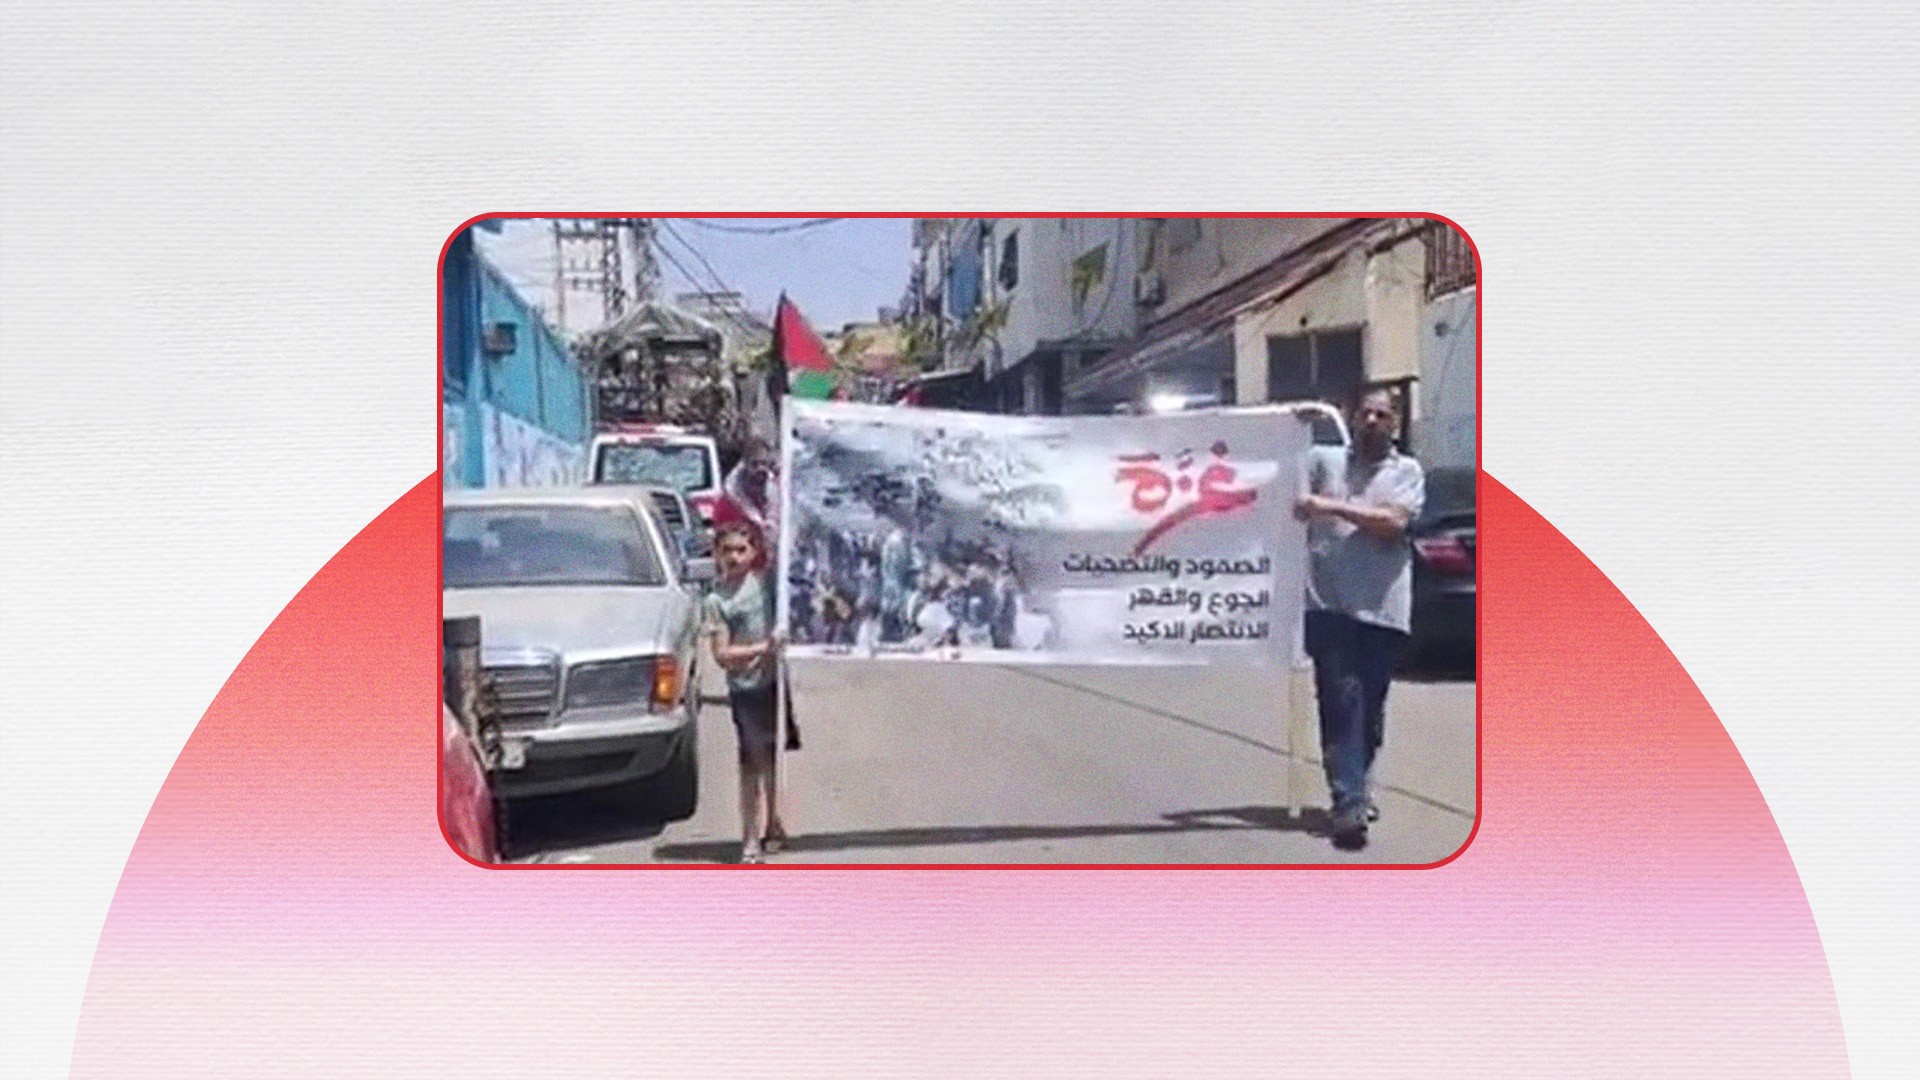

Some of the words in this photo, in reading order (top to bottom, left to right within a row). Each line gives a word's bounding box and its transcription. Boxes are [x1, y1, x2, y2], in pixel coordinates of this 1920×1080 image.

[1062, 554, 1180, 578] والتضحيات
[1186, 556, 1271, 579] الصمود
[1128, 588, 1201, 612] والقهر
[1208, 590, 1270, 615] الجوع
